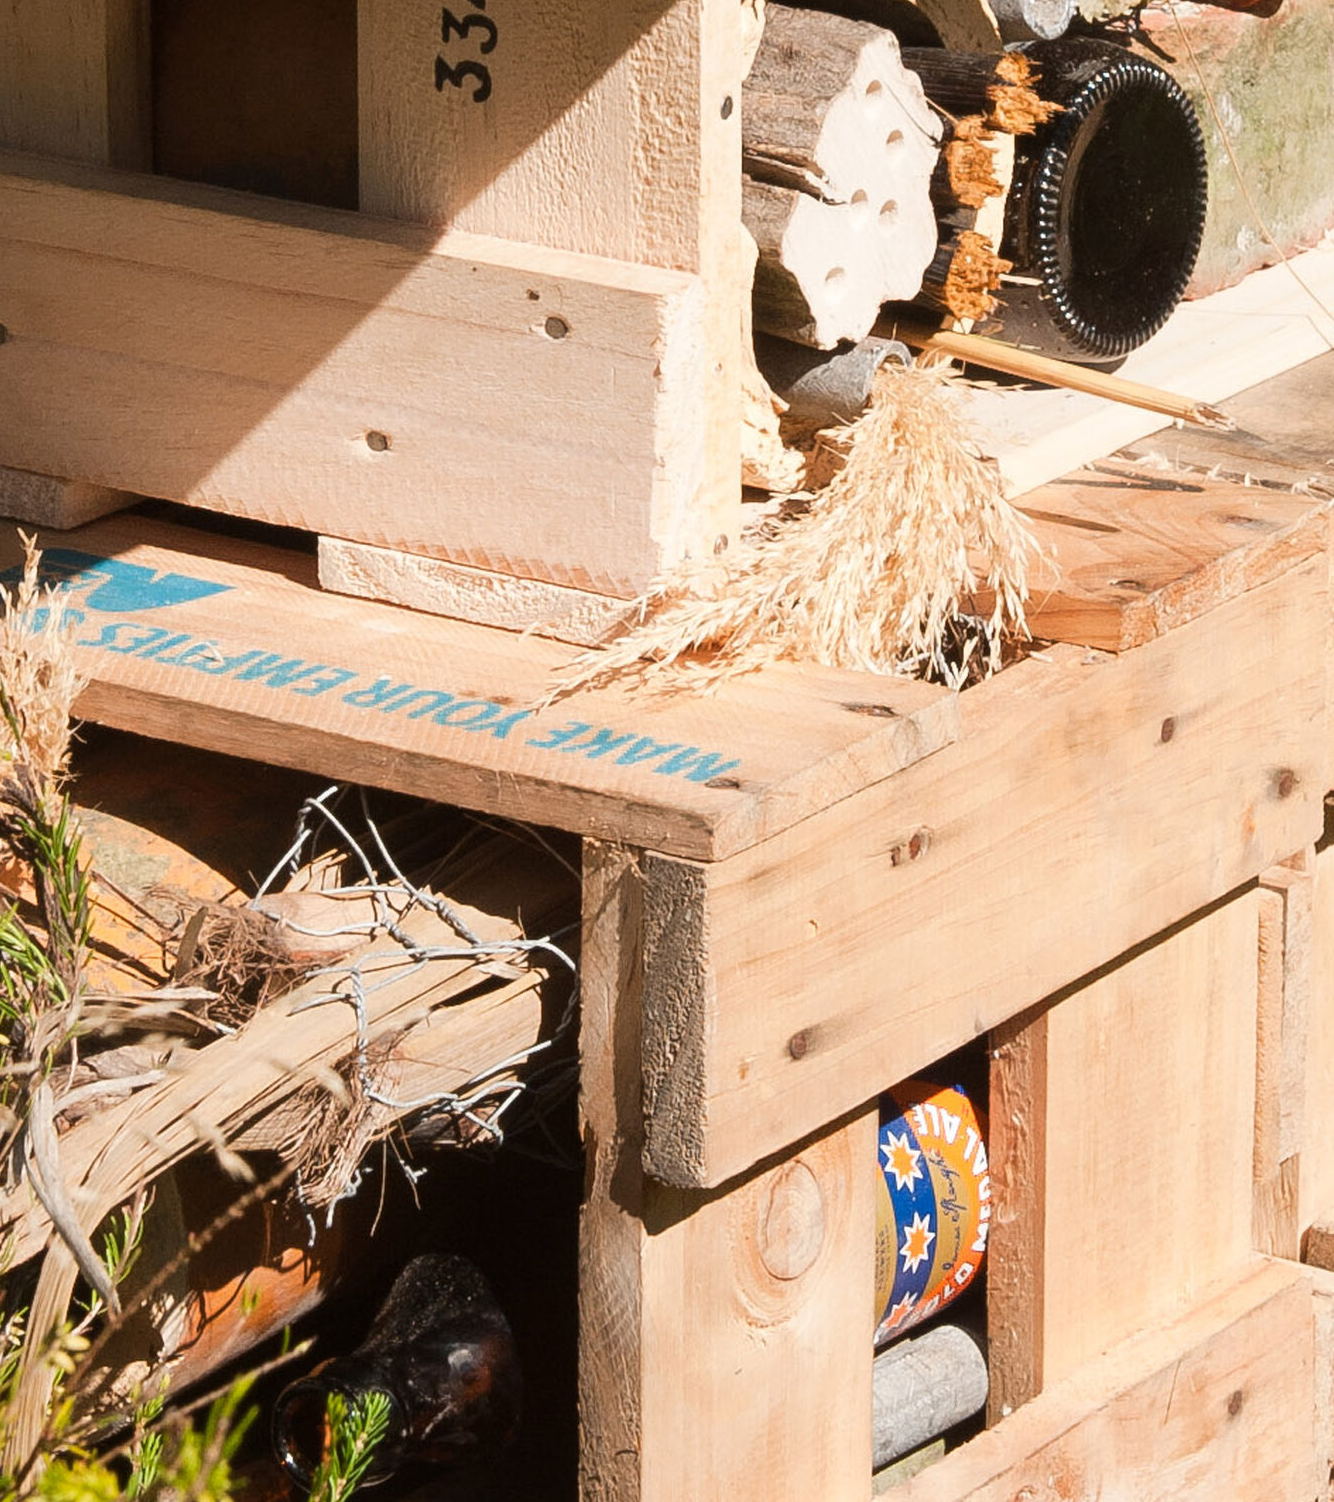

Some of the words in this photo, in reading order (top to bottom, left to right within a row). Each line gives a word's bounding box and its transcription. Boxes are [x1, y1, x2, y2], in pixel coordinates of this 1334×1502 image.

[79, 621, 354, 698] EMPTIES
[342, 675, 535, 739] YOUR
[526, 720, 740, 782] MAKE
[912, 1102, 961, 1144] ALE
